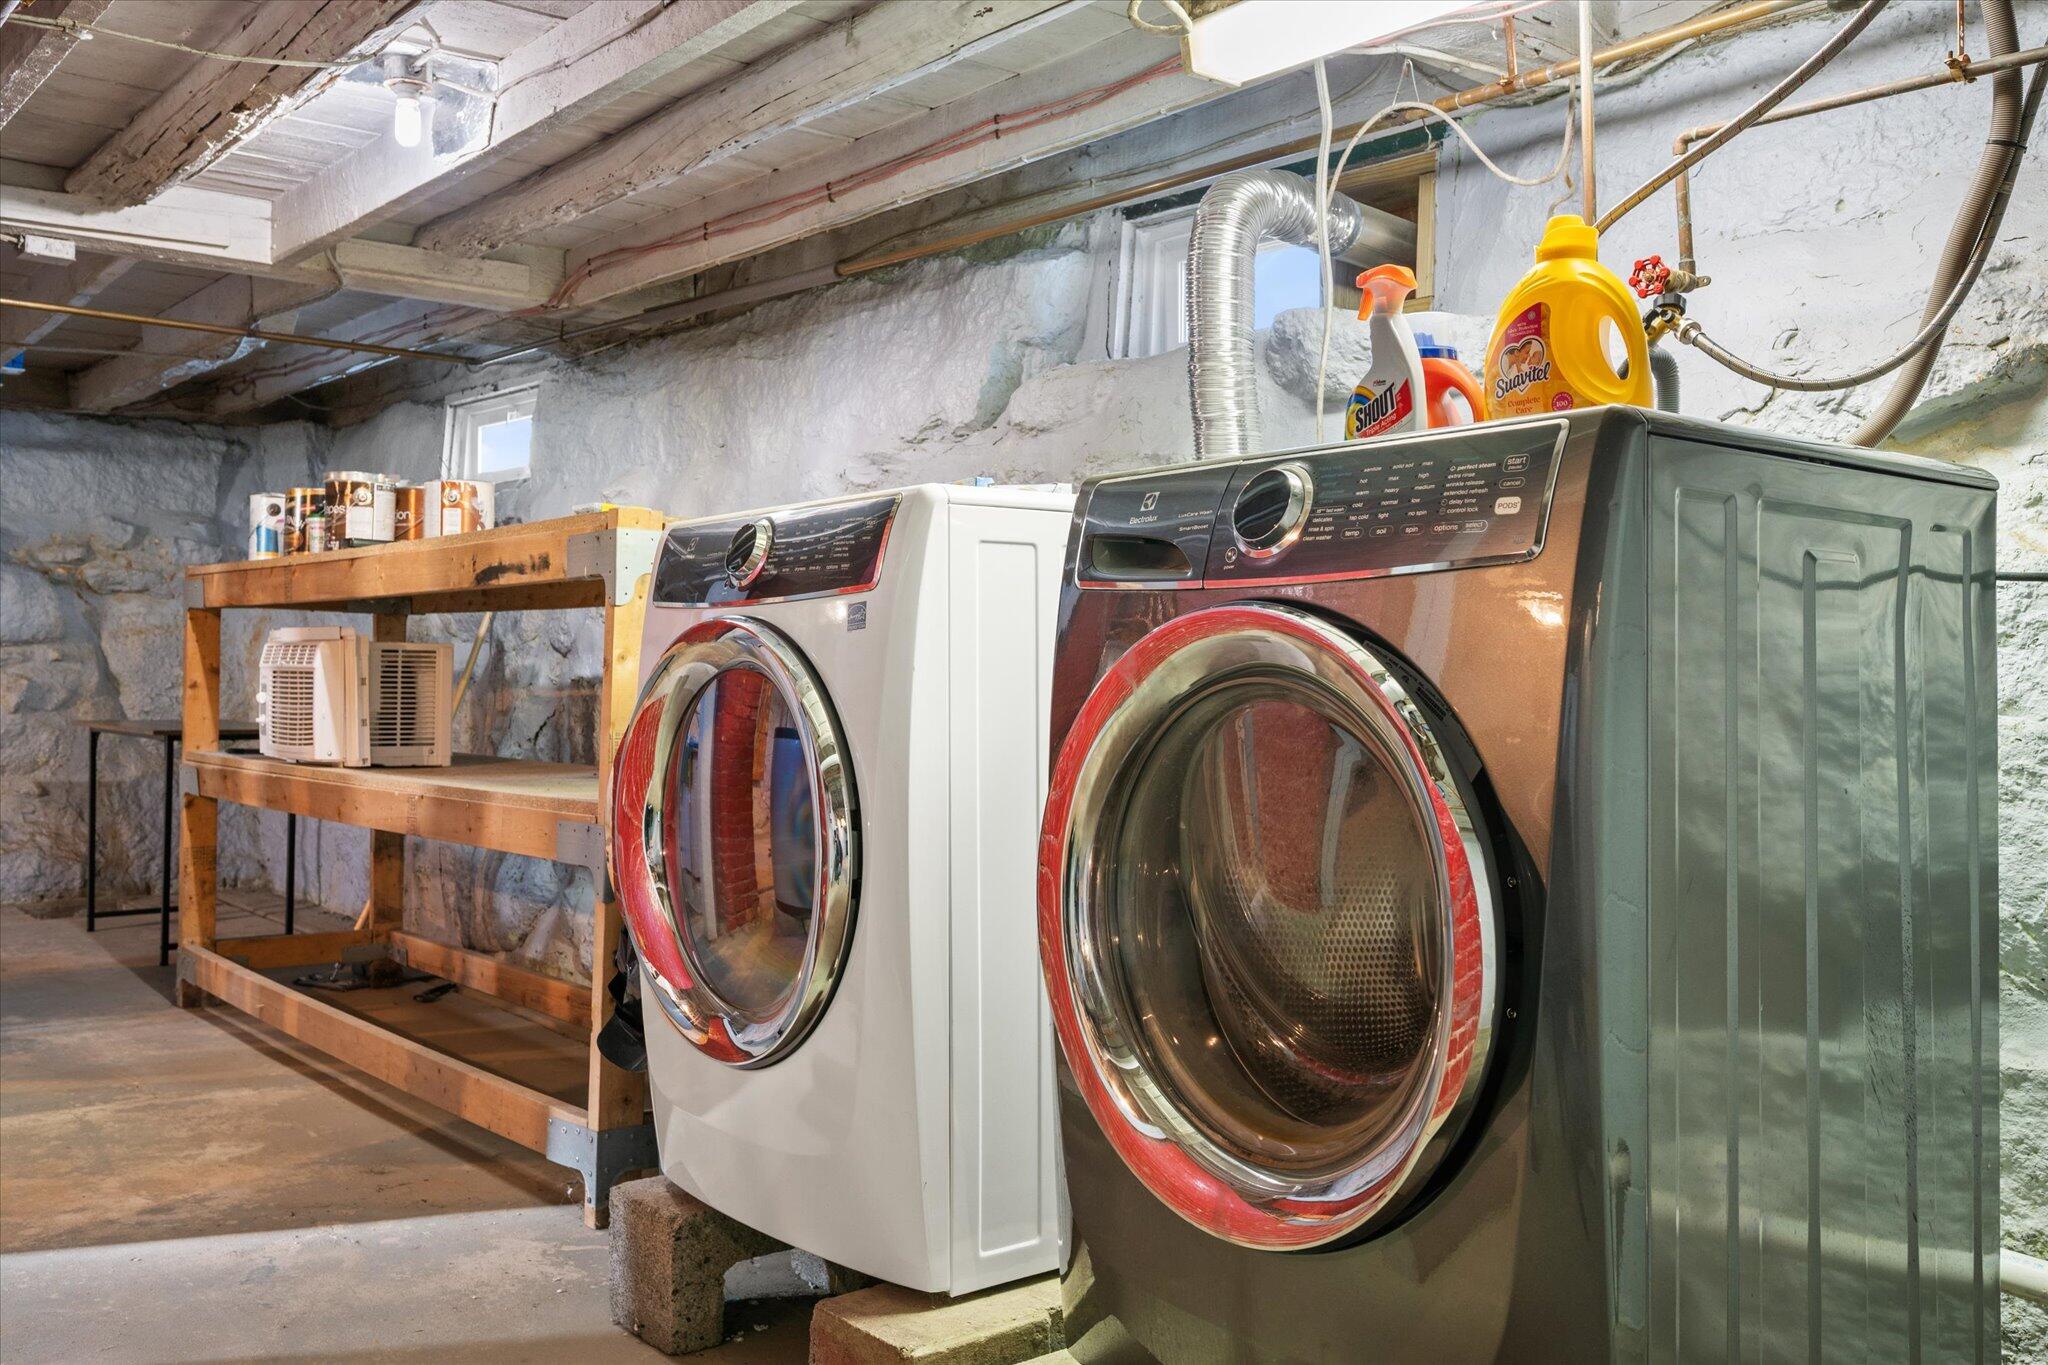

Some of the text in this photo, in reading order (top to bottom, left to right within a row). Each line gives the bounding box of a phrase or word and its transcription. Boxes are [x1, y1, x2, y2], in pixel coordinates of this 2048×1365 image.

[1496, 361, 1551, 399] Suavitel
[1507, 396, 1541, 408] Complete
[1355, 382, 1397, 433] SHOUT
[1365, 424, 1380, 436] Triple
[1380, 413, 1397, 428] Acting
[1507, 456, 1527, 465] start
[1448, 499, 1464, 507] delay
[1129, 514, 1159, 525] Electrolux
[1465, 520, 1483, 529] select
[1376, 526, 1387, 535] soil
[1405, 525, 1419, 535] spin
[1434, 522, 1459, 532] options
[1345, 529, 1360, 539] temp
